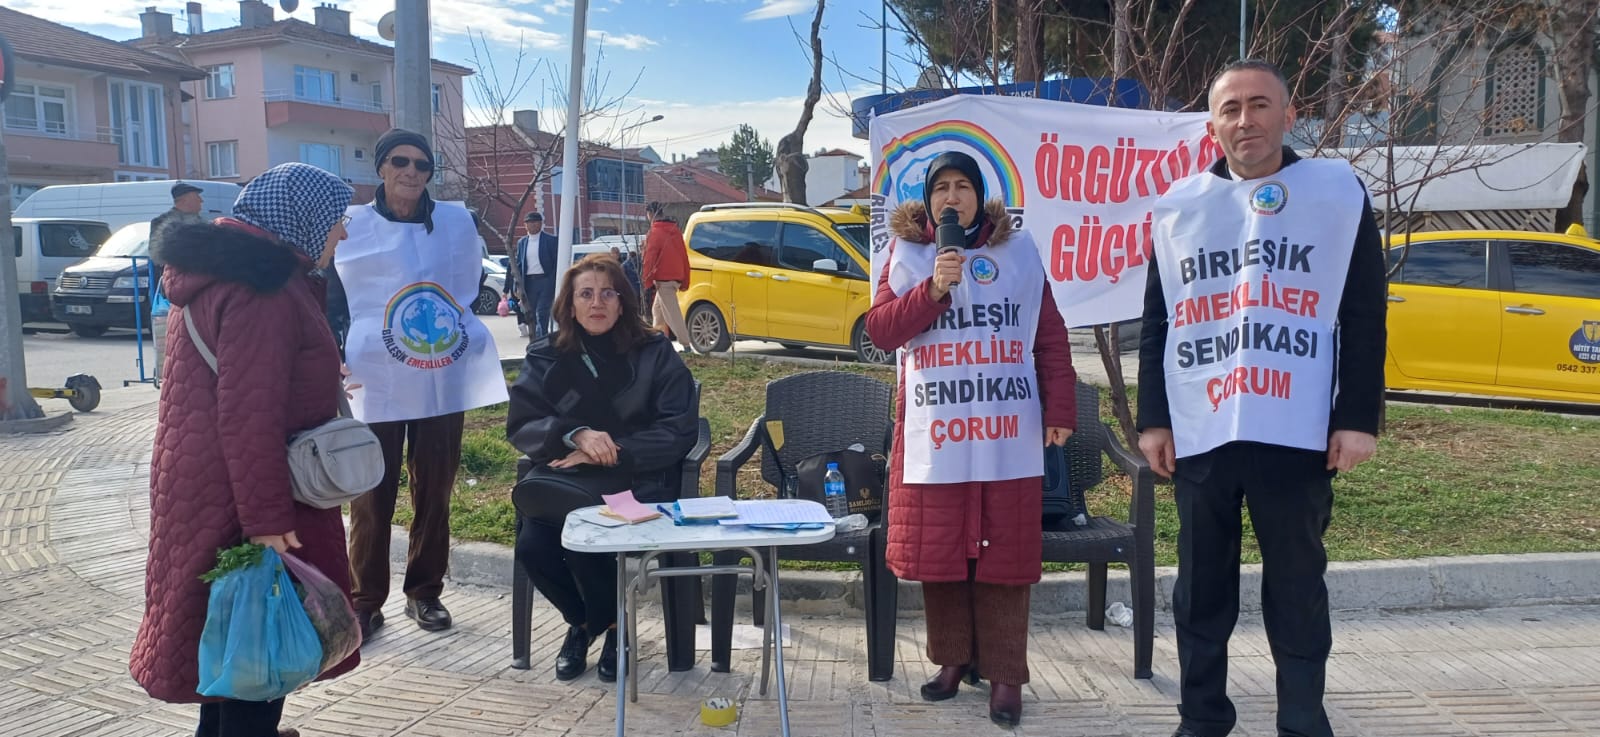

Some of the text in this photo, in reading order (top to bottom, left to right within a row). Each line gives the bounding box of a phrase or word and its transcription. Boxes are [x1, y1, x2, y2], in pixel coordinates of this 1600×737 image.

[1180, 237, 1315, 285] BİRLEŞİK
[922, 297, 1021, 333] RLEŞİK
[1175, 274, 1320, 328] EMEKLİLER
[913, 335, 1025, 371] EMEKLİLER
[1177, 316, 1318, 368] SENDİKASI
[1556, 363, 1597, 374] 0542 337
[914, 372, 1032, 407] SENDİKASI
[1206, 366, 1292, 412] ÇORUM
[930, 415, 1018, 450] ÇORUM
